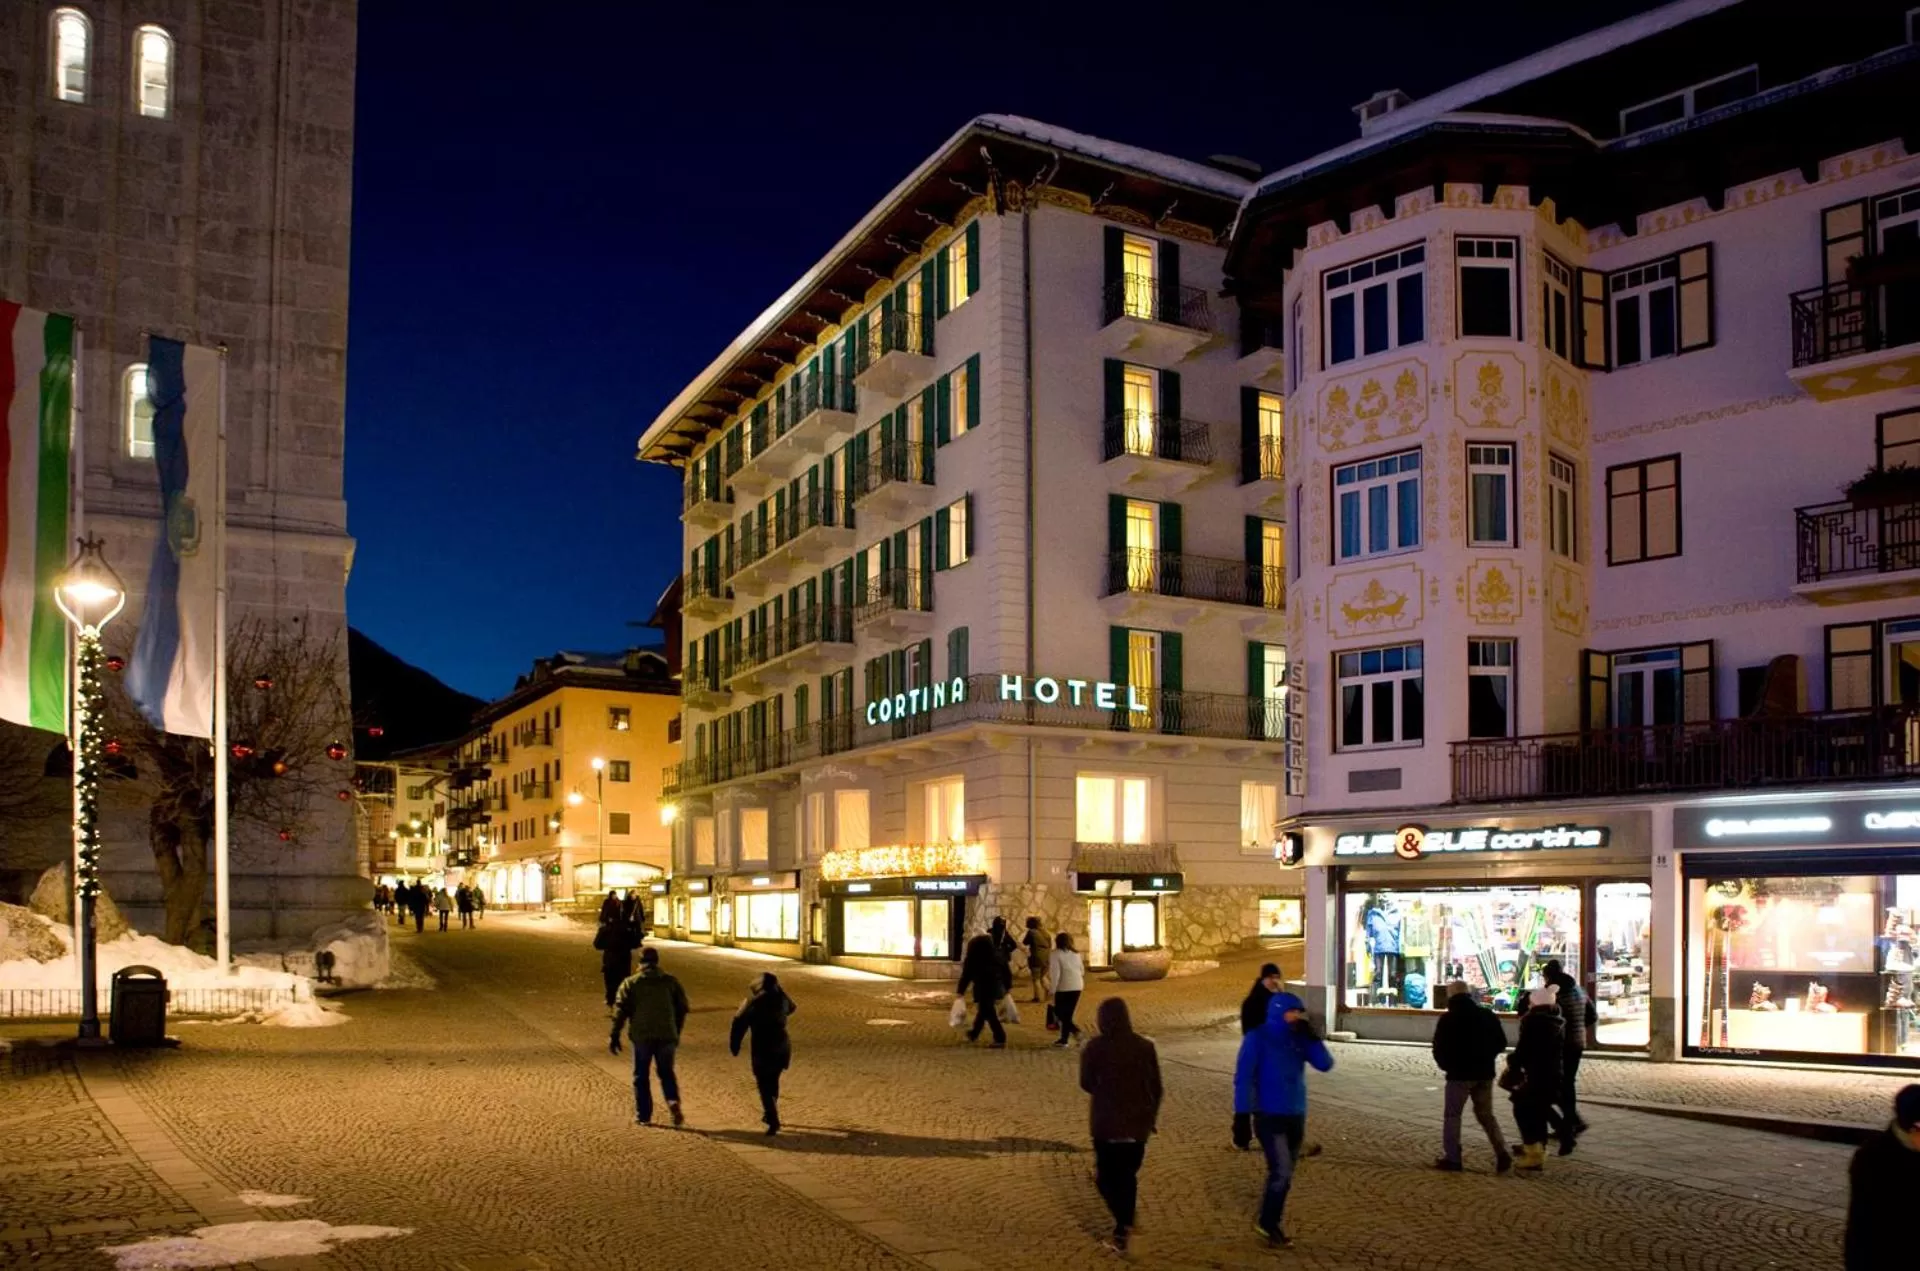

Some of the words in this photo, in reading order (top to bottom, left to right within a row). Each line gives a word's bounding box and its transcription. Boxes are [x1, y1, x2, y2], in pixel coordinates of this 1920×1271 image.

[867, 676, 964, 725] CORTINA
[1001, 674, 1148, 711] HOTEL
[1291, 662, 1303, 794] SPORT
